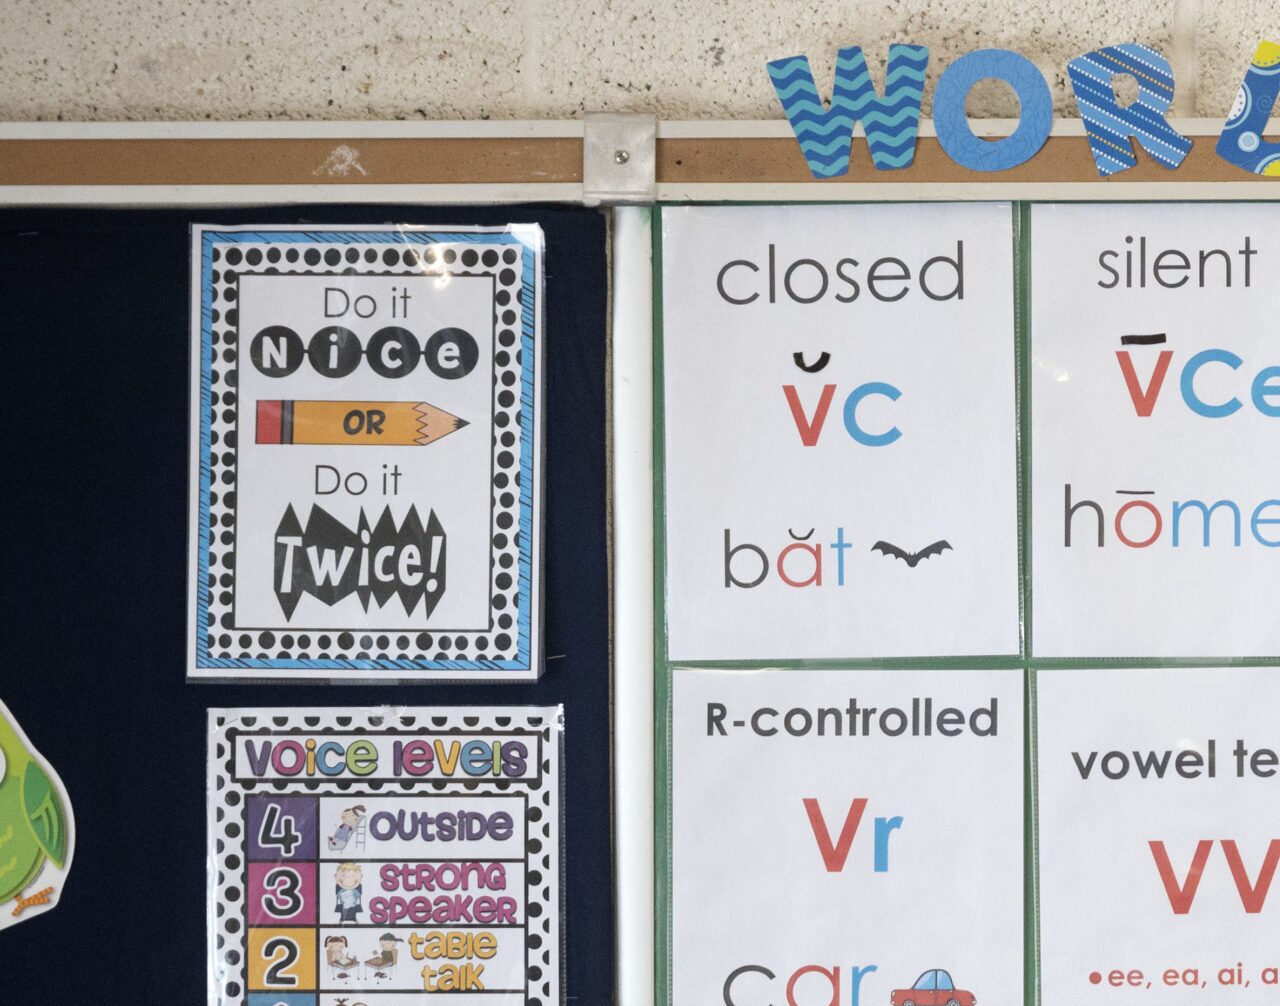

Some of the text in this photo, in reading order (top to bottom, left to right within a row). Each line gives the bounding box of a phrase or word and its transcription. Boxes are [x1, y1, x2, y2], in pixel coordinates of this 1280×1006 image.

[717, 240, 964, 305] closed
[1098, 236, 1257, 288] silent
[324, 287, 411, 319] Do it
[258, 332, 467, 371] Nice
[343, 410, 386, 434] OR
[314, 463, 402, 496] Do it
[276, 528, 444, 594] Twice!
[707, 698, 998, 736] R-controlled
[1072, 740, 1215, 779] vowel
[259, 804, 301, 856] 4
[802, 798, 904, 872] Vr
[263, 867, 303, 918] 3
[263, 937, 298, 988] 2
[1108, 970, 1152, 989] ee,
[1163, 968, 1206, 988] ea,
[1218, 963, 1250, 988] ai,
